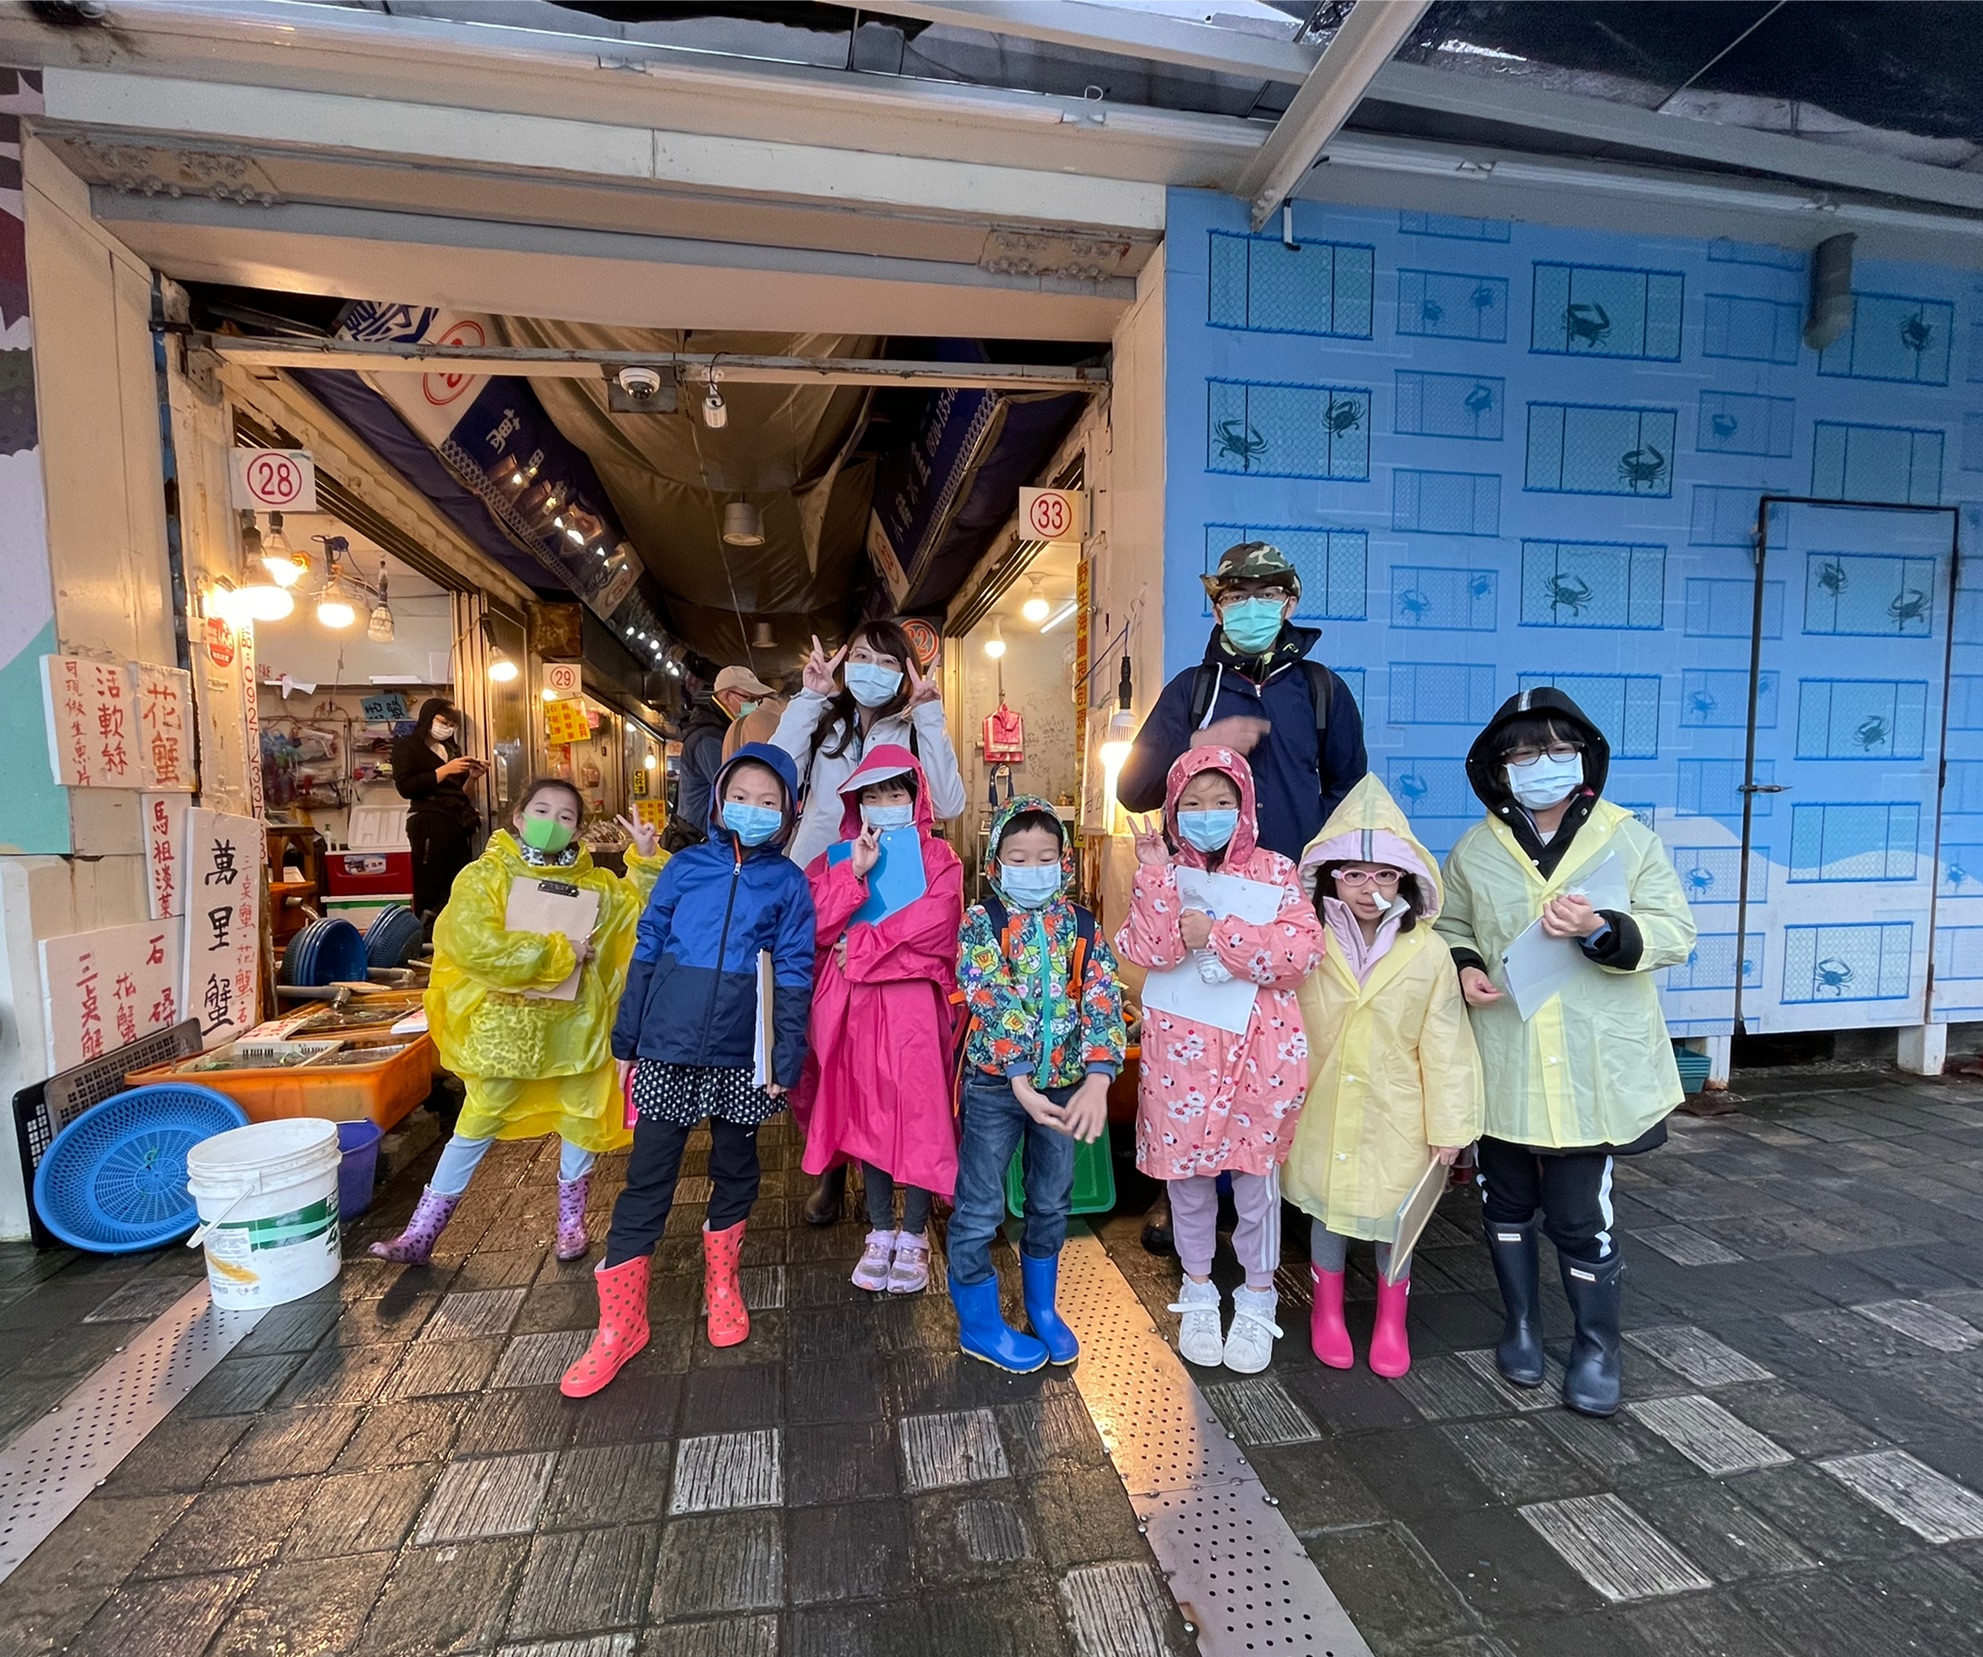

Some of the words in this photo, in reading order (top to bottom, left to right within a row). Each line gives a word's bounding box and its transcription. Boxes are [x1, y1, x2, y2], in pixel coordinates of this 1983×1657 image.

[259, 462, 293, 497] 28
[1038, 499, 1063, 530] 33
[555, 670, 571, 687] 29
[95, 666, 128, 776] 活軟絲
[143, 682, 182, 785] 花蟹
[202, 838, 238, 1036] 萬里蟹
[113, 972, 137, 1045] 花蟹
